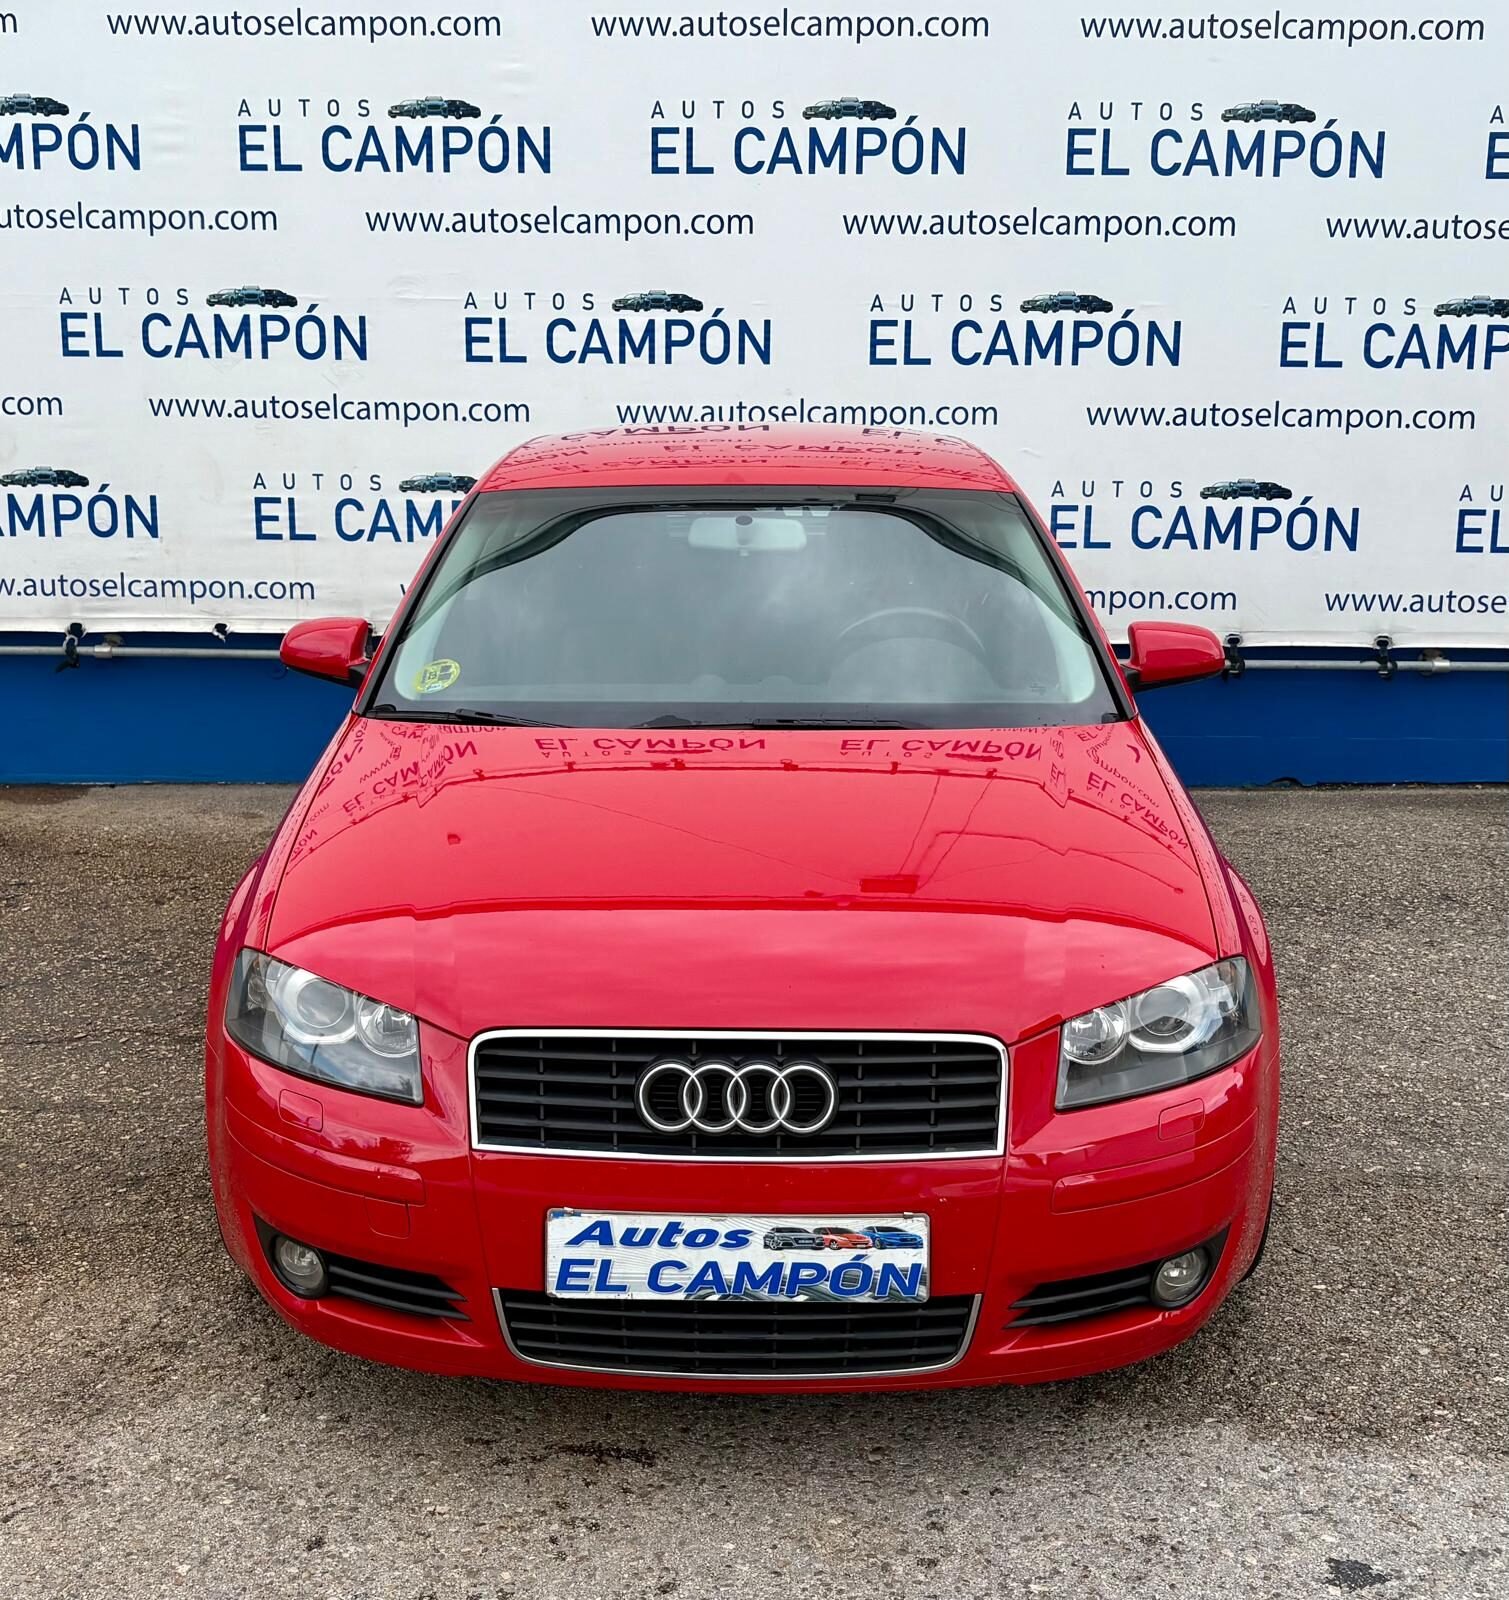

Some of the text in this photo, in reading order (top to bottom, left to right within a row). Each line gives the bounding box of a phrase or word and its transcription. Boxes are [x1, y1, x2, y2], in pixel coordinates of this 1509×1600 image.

[107, 8, 500, 43] www.autoselcampon.com
[592, 8, 988, 44] www.autoselcampon.com
[1081, 11, 1484, 47] www.autoselcampon.com
[238, 99, 369, 117] AUTOS
[651, 101, 784, 119] AUTOS
[1068, 102, 1202, 121] AUTOS
[239, 115, 552, 174] EL CAMPÓN
[652, 116, 966, 175] EL CAMPÓN
[1066, 119, 1386, 179] EL CAMPÓN
[366, 206, 753, 241] www.autoselcampon.com
[843, 207, 1235, 242] www.autoselcampon.com
[60, 287, 188, 305] AUTOS
[464, 292, 594, 310] AUTOS
[870, 294, 1002, 312] AUTOS
[1283, 297, 1415, 315] AUTOS
[61, 304, 367, 361] EL CAMPÓN
[465, 308, 771, 365] EL CAMPÓN
[870, 310, 1182, 367] EL CAMPÓN
[1280, 322, 1342, 368] EL
[149, 393, 530, 424] www.autoselcampon.com
[1087, 401, 1475, 434] www.autoselcampon.com
[254, 473, 381, 491] AUTOS
[1051, 481, 1182, 498] AUTOS
[1459, 485, 1503, 501] AU
[254, 497, 316, 541] EL
[1131, 497, 1360, 552] CAMPÓN
[565, 1219, 752, 1249] Autos
[555, 1254, 922, 1297] EL CAMPÓN
